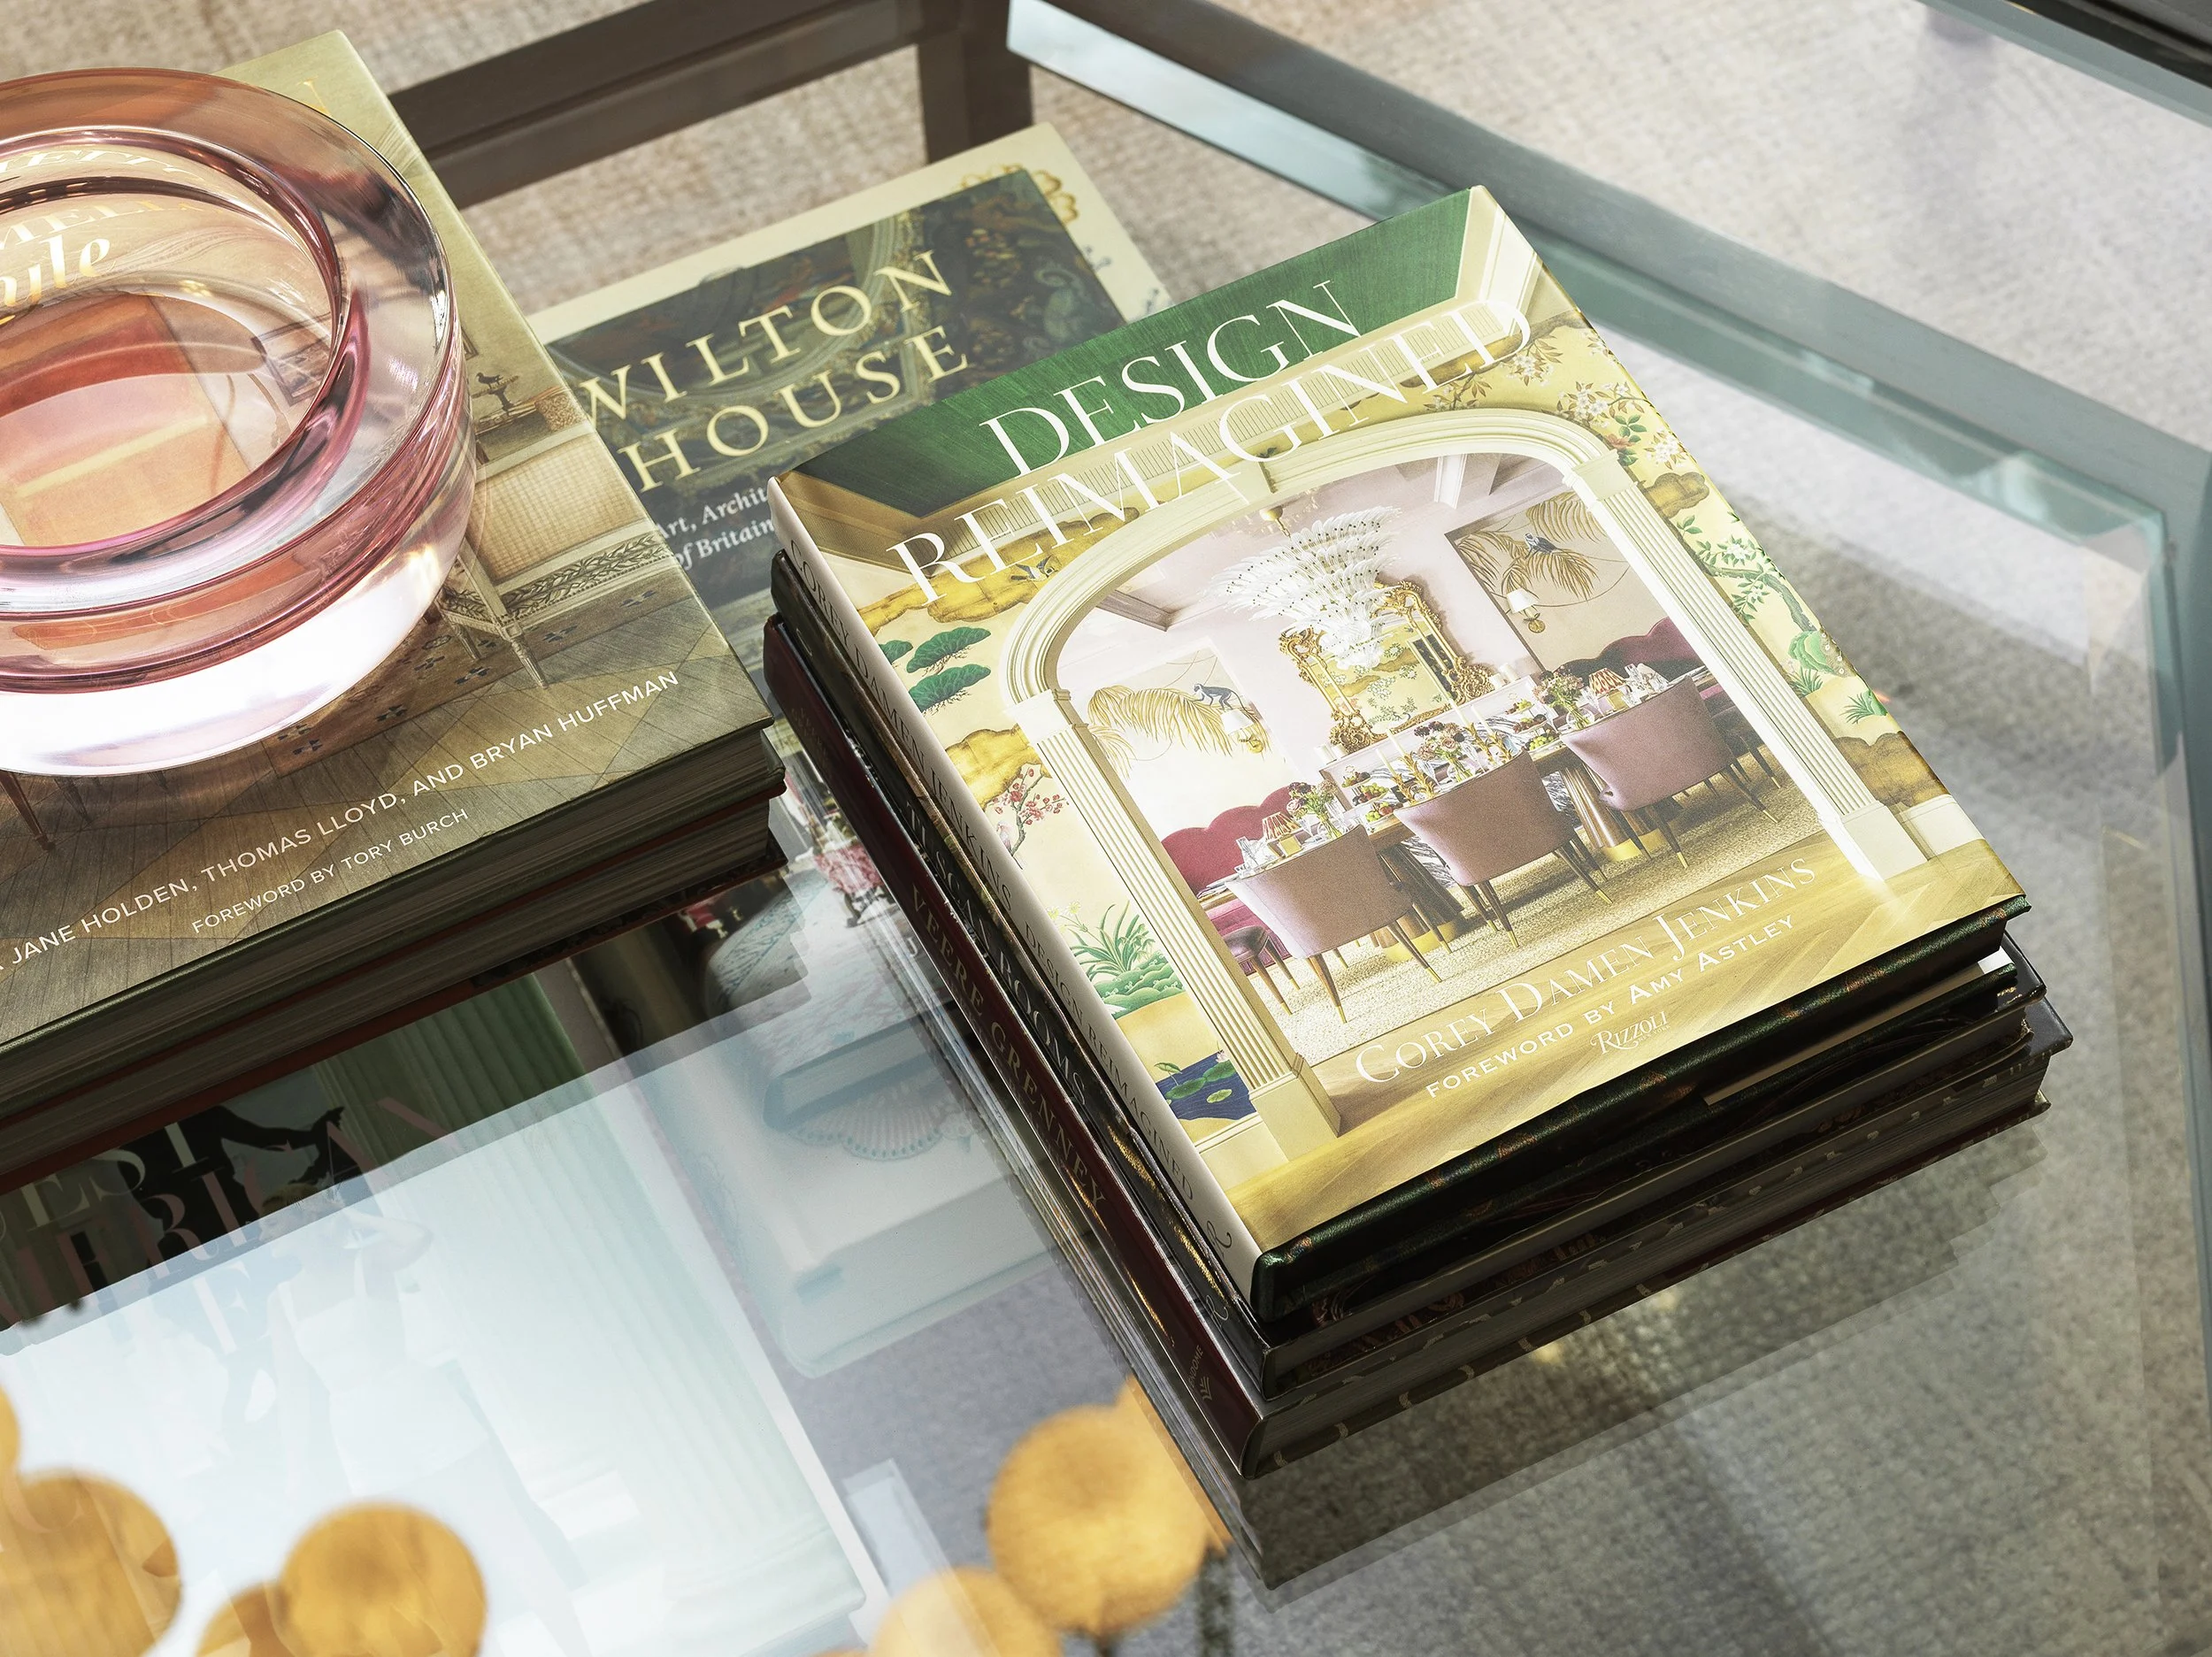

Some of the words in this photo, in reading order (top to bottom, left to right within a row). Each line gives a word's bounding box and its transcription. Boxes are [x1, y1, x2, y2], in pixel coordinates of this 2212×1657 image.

[580, 250, 952, 426] WILTON
[618, 326, 968, 492] HOUSE
[979, 280, 1360, 479] DESIGN
[887, 301, 1530, 606] REIMAGINED
[12, 924, 76, 964] JANE
[81, 878, 197, 933] HOLDEN,
[201, 829, 311, 882] THOMAS
[317, 793, 406, 835] LLOYD,
[413, 763, 464, 796] AND
[470, 724, 553, 771] BRYAN
[557, 671, 679, 733] HUFFMAN
[192, 878, 305, 933] FOREWORD
[311, 864, 334, 884] BY
[341, 840, 392, 870] TORY
[399, 809, 468, 846] BURCH
[791, 540, 851, 651] COREY
[856, 652, 926, 773] DAMEN
[932, 769, 1012, 912] JENKINS
[1025, 924, 1085, 1024] DESIGN
[1087, 1029, 1193, 1201] REIMAGINED
[910, 883, 985, 1016] VEERE
[993, 1020, 1107, 1204] GRENNEY
[1000, 960, 1087, 1108] ROOMS
[1355, 1008, 1500, 1085] COREY
[1497, 936, 1655, 1024] DAMEN
[1652, 857, 1816, 962] JENKINS
[1425, 1022, 1574, 1099] FOREWORD
[1582, 1001, 1617, 1025] BY
[1628, 969, 1686, 1004] AMY
[1698, 916, 1795, 972] ASTLEY
[1590, 1011, 1668, 1054] RIZZOLI
